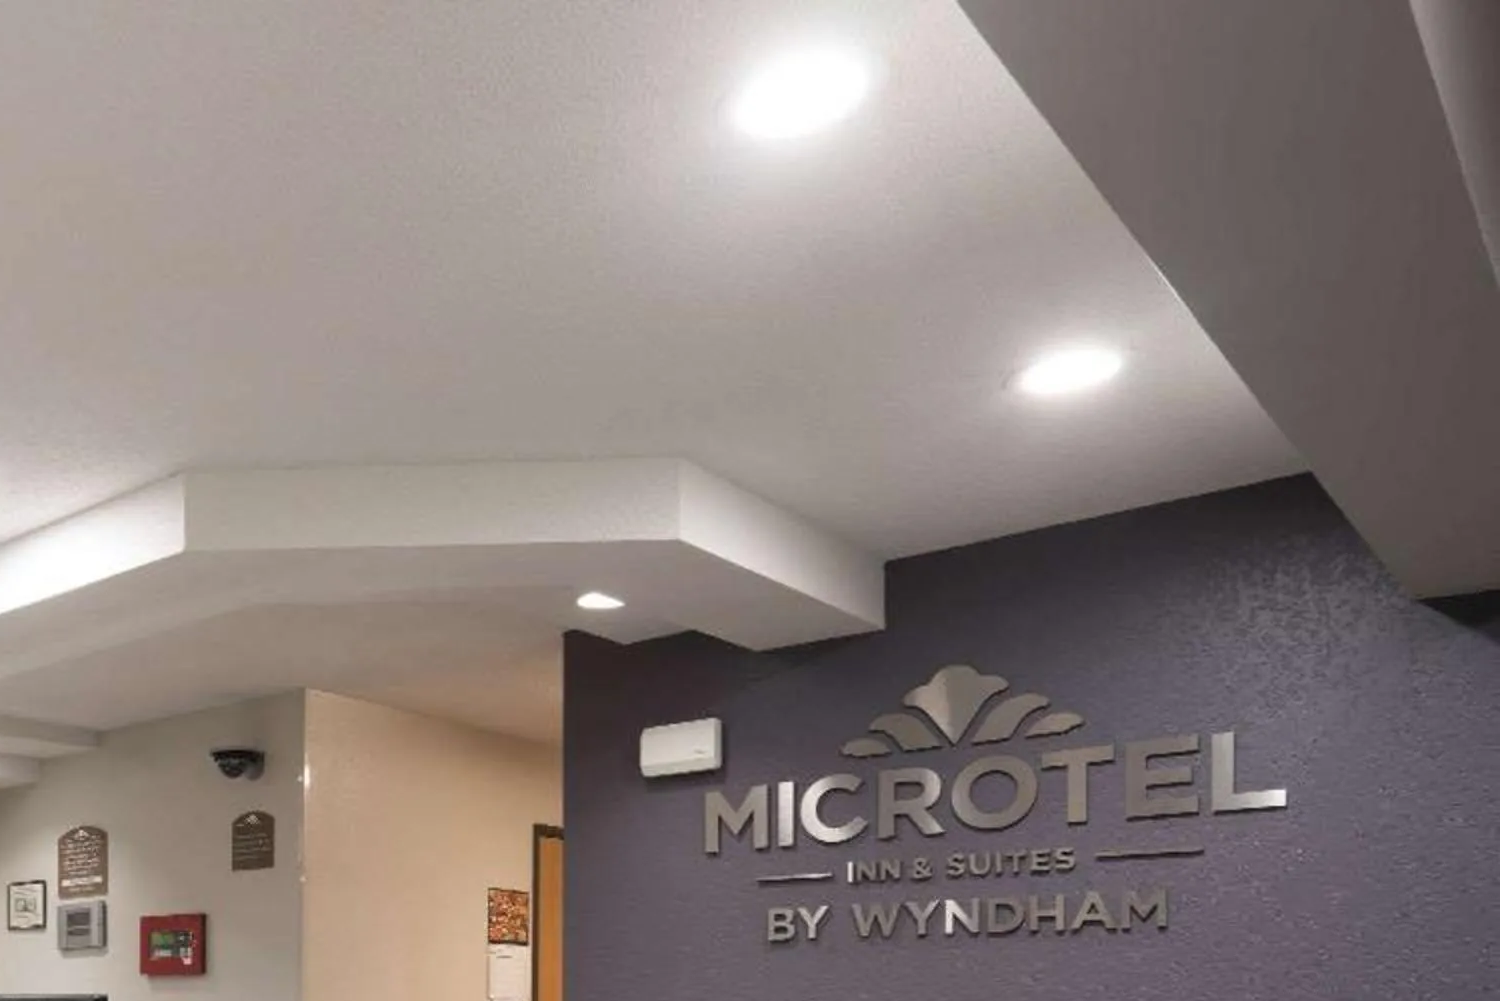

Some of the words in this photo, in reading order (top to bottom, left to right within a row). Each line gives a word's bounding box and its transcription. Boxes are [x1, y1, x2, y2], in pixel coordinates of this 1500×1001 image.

[704, 731, 1287, 854] MICROTEL
[847, 859, 901, 883] INN
[911, 856, 933, 880] &
[946, 847, 1076, 877] SUITES
[768, 905, 830, 942] BY
[852, 888, 1168, 937] WYNDHAM
